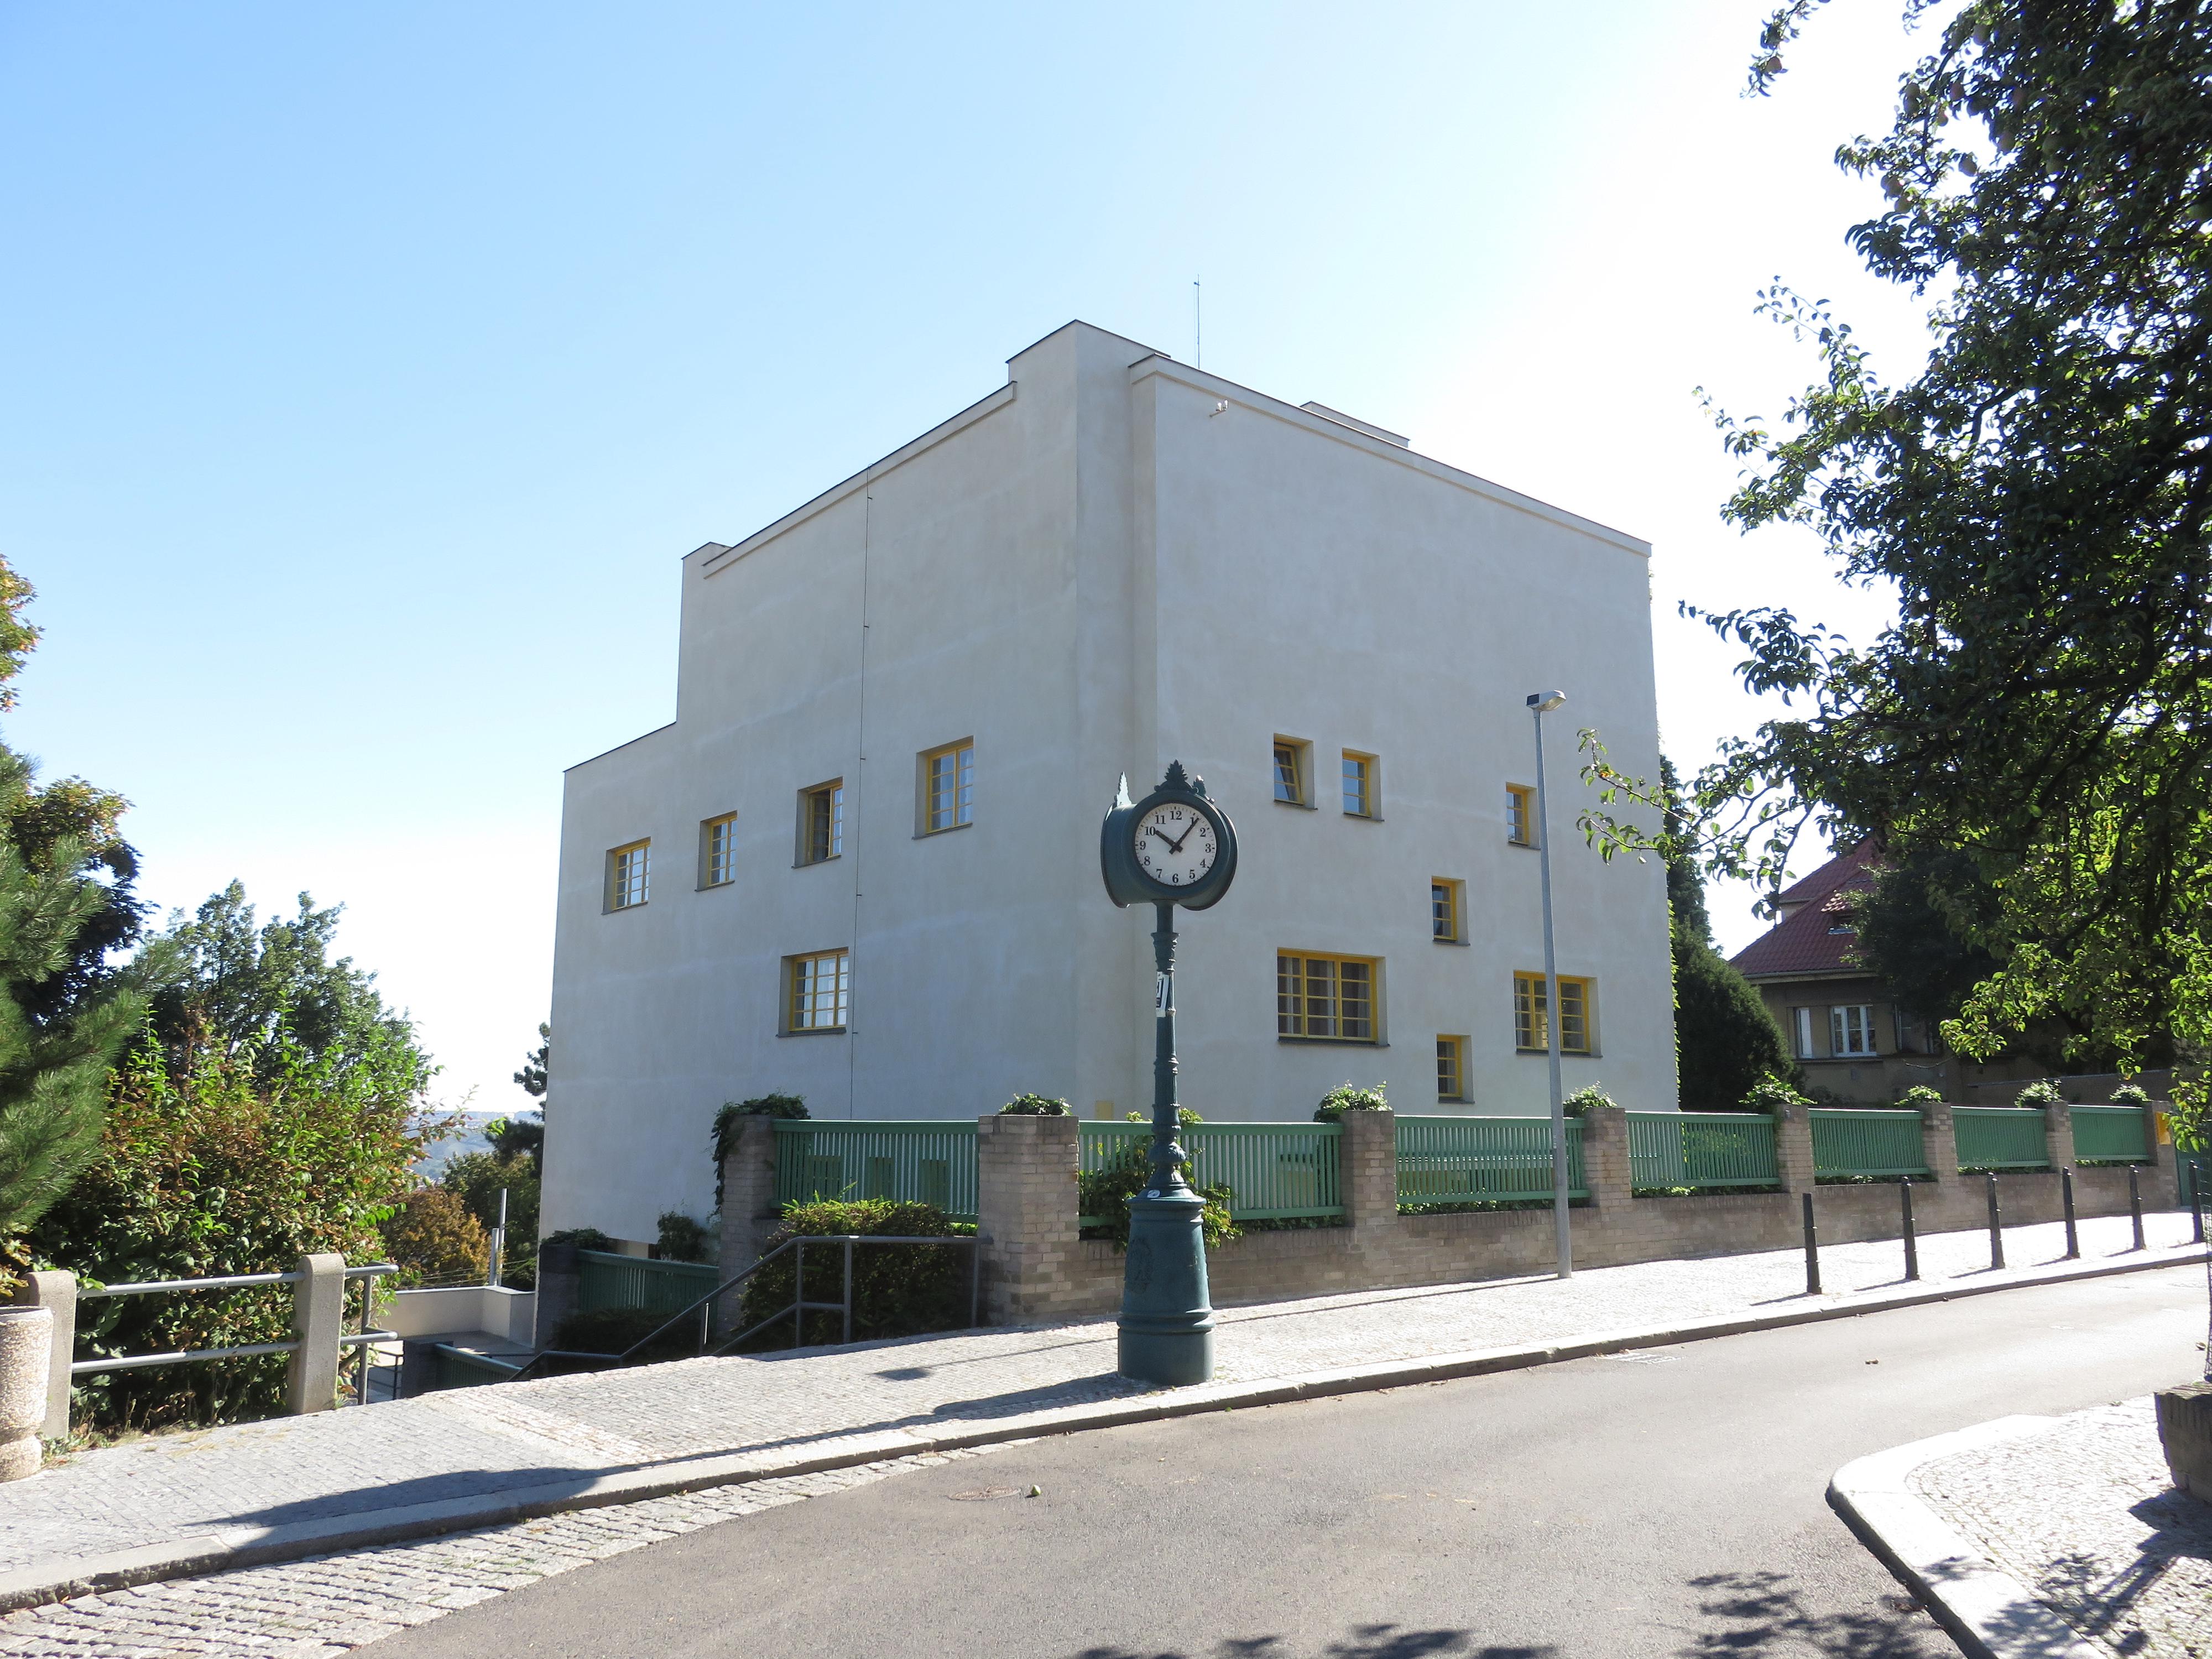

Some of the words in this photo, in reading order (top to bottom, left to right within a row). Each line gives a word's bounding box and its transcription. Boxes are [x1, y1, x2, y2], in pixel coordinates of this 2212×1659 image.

[1155, 815, 1166, 824] 11
[1170, 811, 1182, 820] 12
[1145, 827, 1156, 835] 10
[1200, 828, 1206, 837] 2
[1140, 841, 1146, 850] 9
[1206, 843, 1211, 853] 3
[1144, 856, 1150, 865] 8
[1200, 859, 1206, 868] 4
[1156, 869, 1162, 878] 7
[1190, 869, 1195, 879] 5
[1172, 874, 1179, 883] 6
